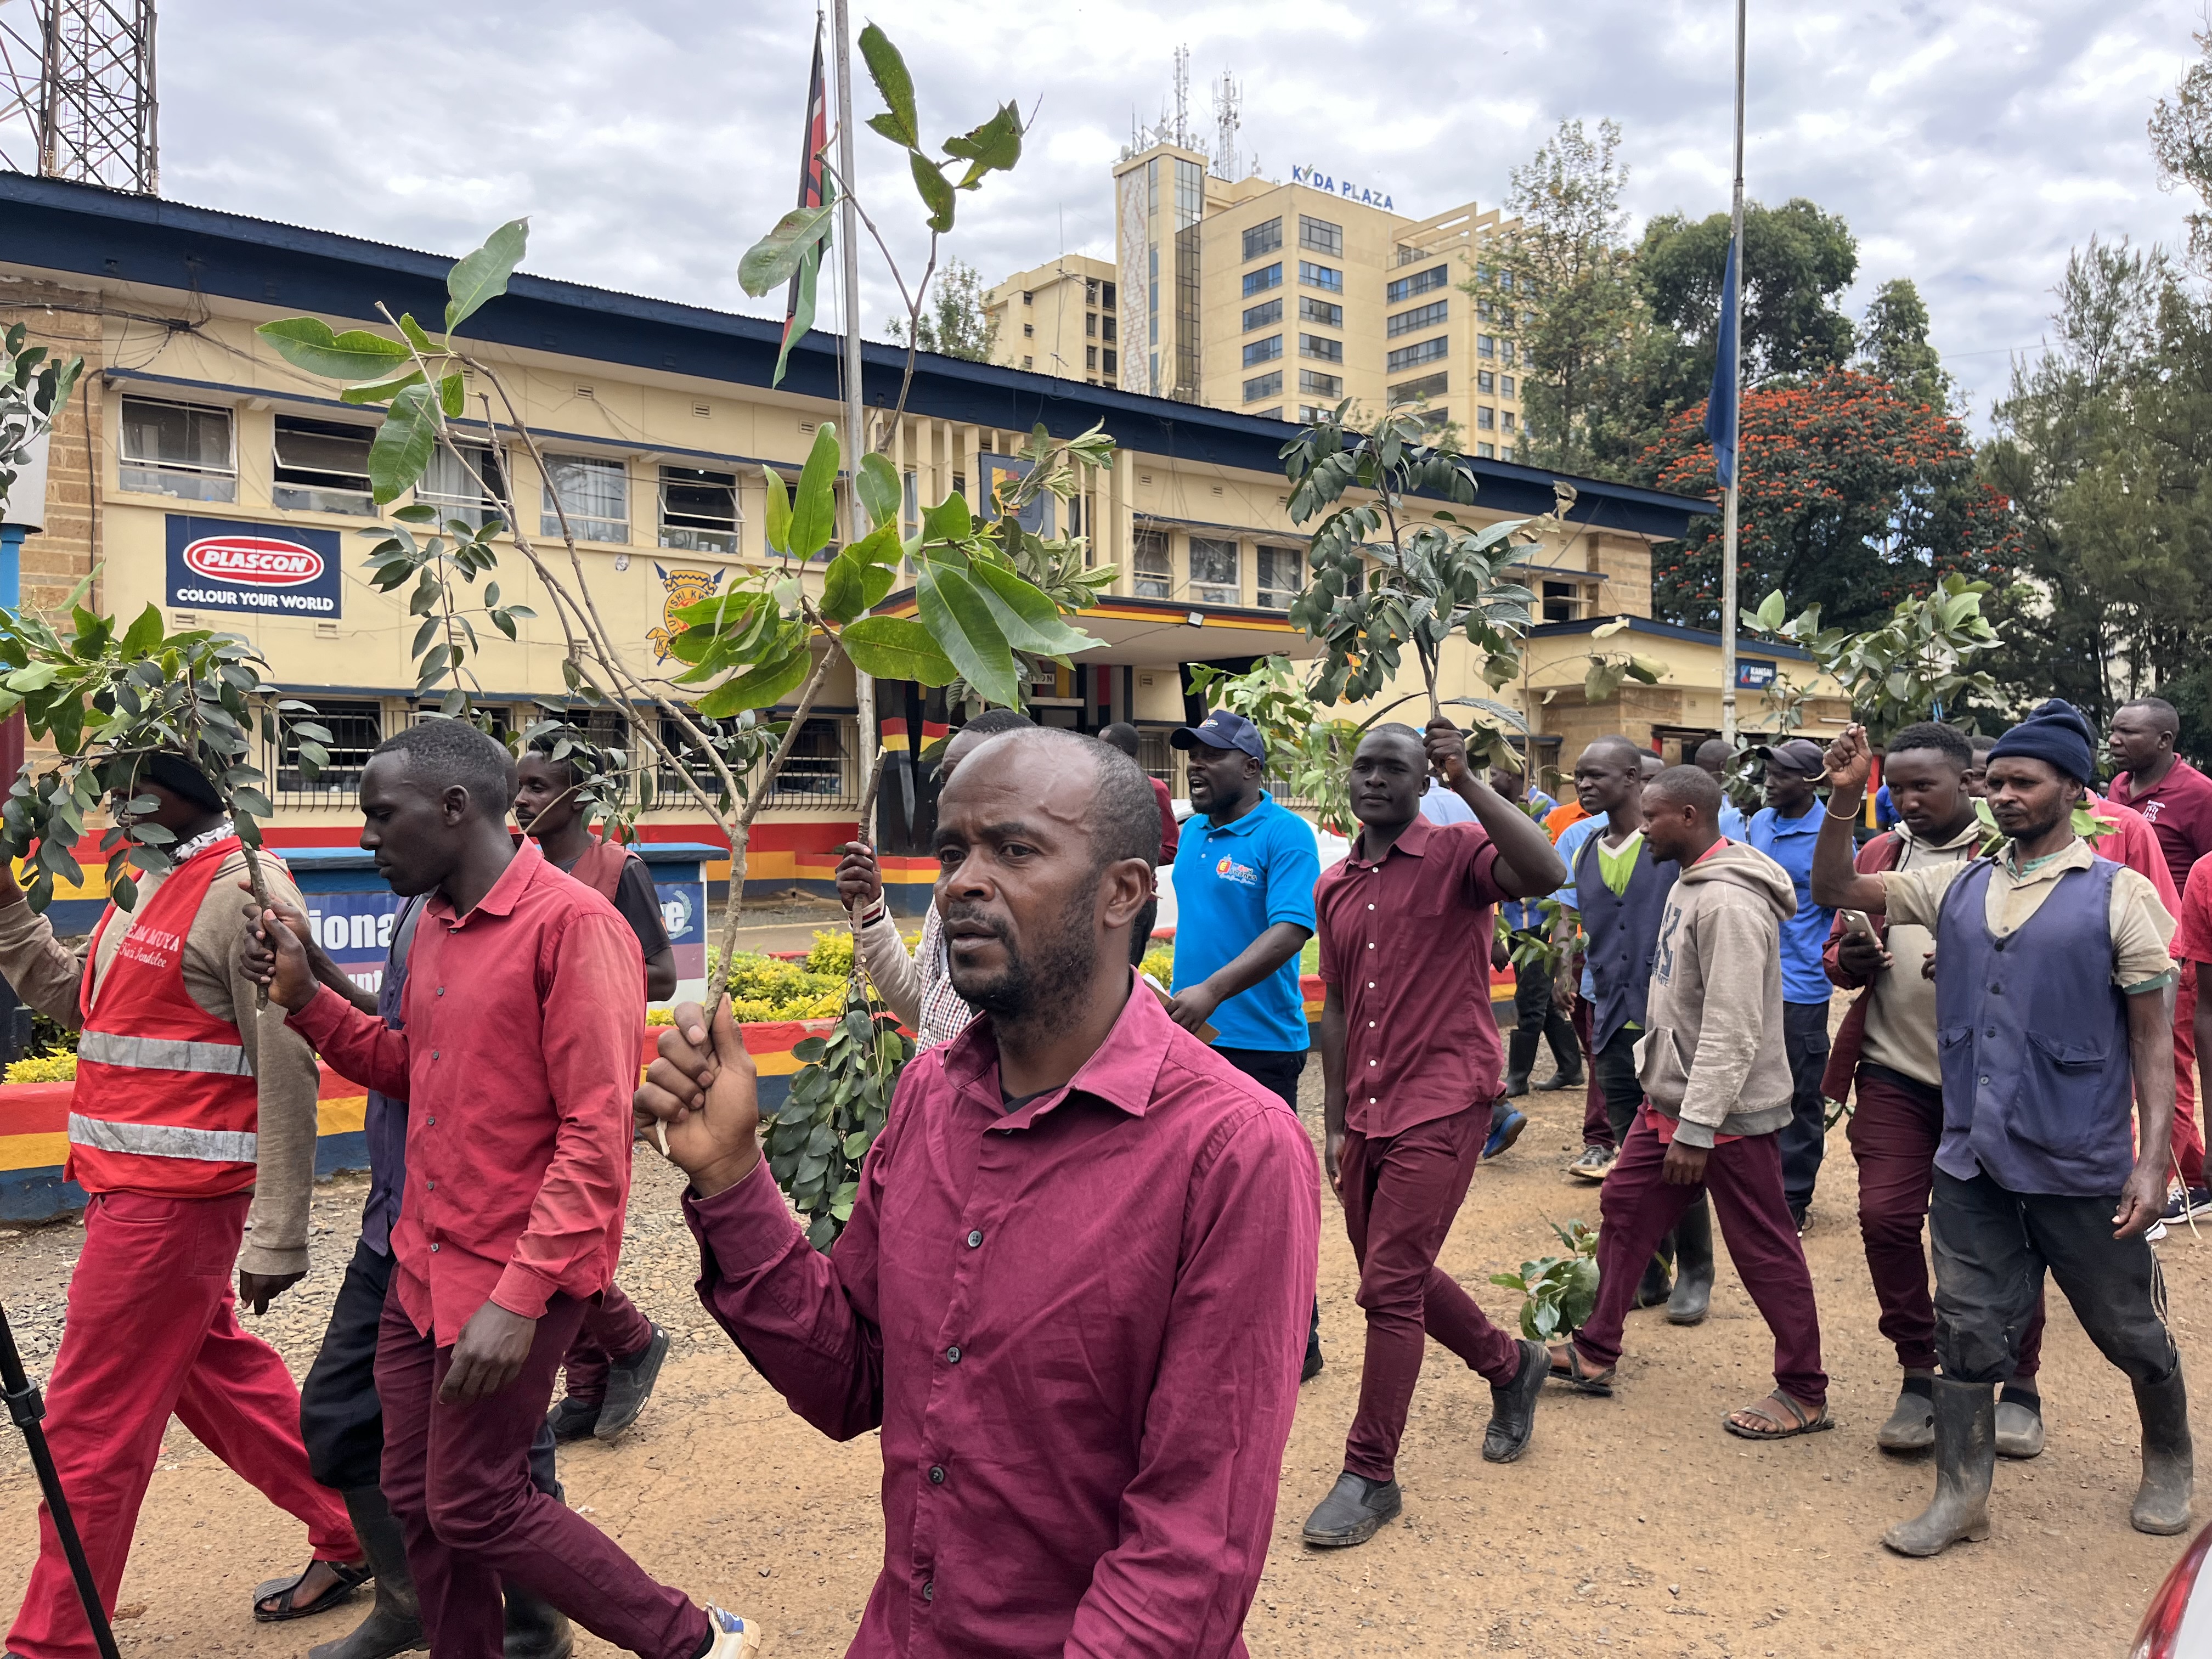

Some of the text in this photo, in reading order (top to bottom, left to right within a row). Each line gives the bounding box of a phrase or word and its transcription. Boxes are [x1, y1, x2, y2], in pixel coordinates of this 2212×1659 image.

[1342, 180, 1394, 210] PLAZA
[202, 550, 308, 572] PLASCON
[177, 588, 334, 611] COLOUR YOUR WORLD
[1750, 666, 1773, 678] KANSAI
[146, 929, 180, 952] MUYA
